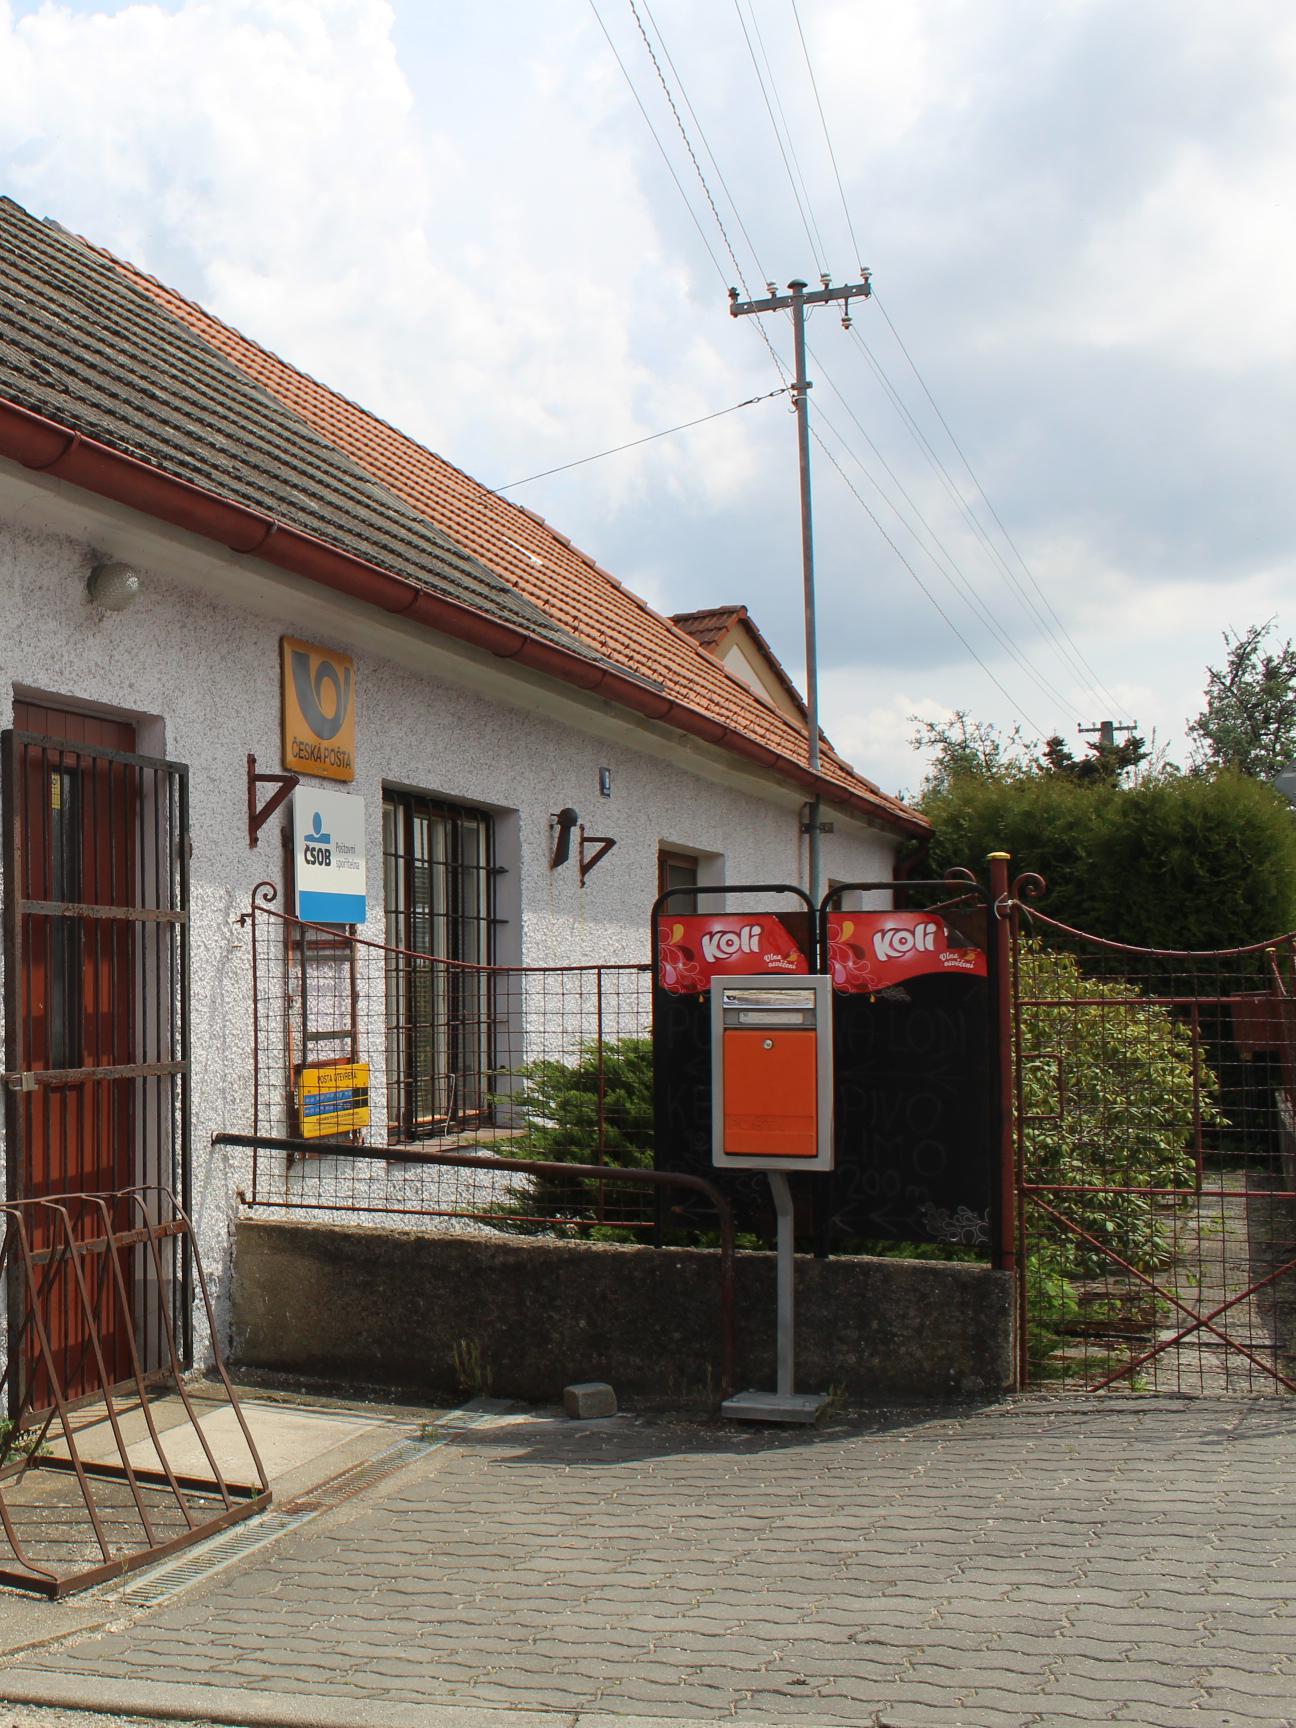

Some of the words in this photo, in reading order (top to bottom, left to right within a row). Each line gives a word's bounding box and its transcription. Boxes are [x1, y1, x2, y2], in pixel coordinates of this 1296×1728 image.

[291, 737, 321, 763] ČESKÁ
[323, 746, 352, 769] POŠTA
[304, 844, 332, 867] ČSOB
